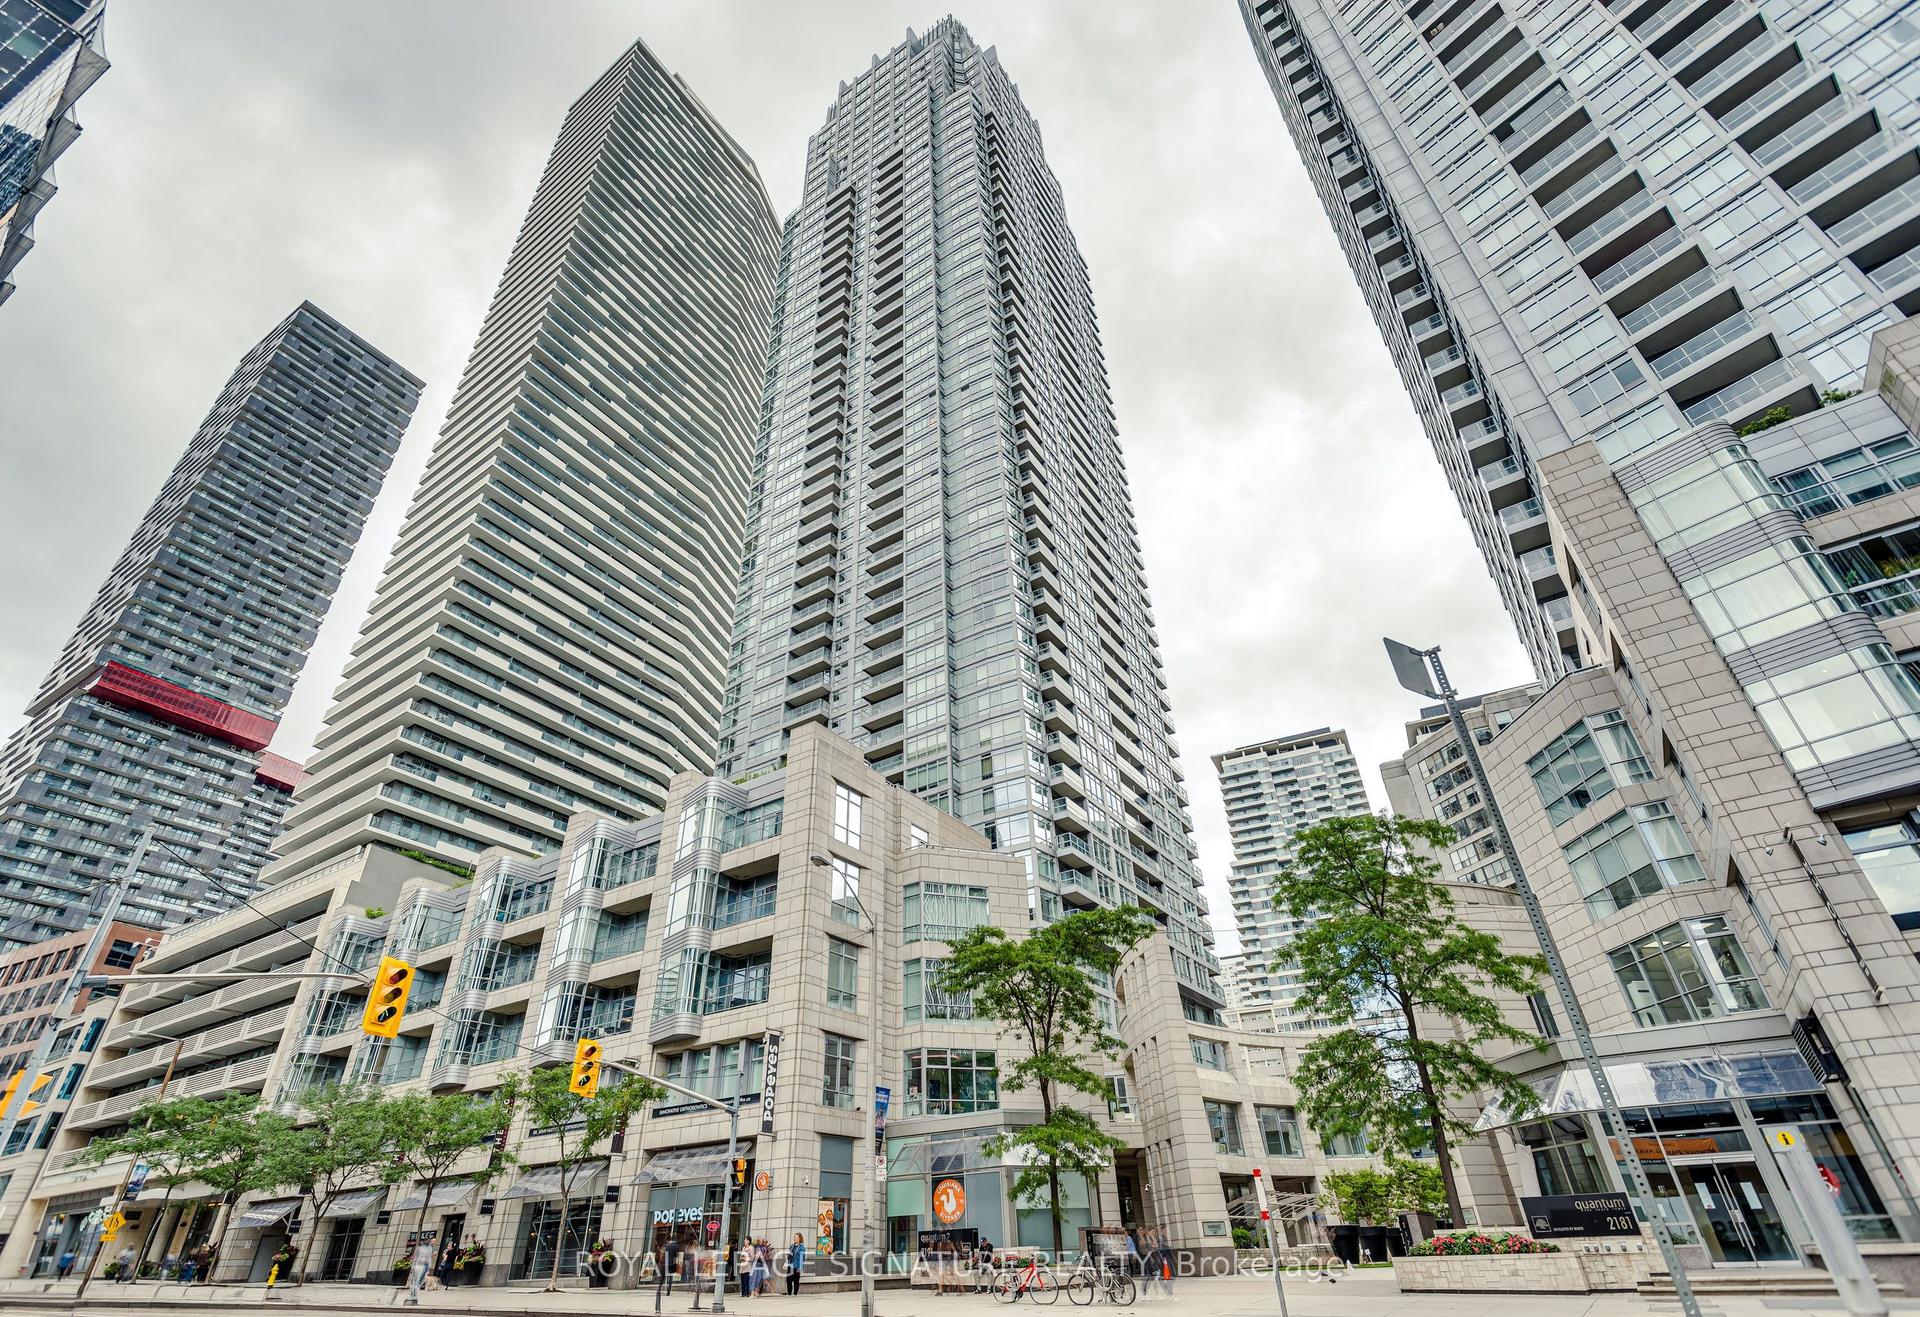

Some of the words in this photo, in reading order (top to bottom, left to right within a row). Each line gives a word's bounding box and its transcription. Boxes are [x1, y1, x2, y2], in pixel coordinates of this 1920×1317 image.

[936, 1182, 961, 1194] LOUISIANA
[1575, 1198, 1625, 1212] quantum
[940, 1211, 961, 1221] KITCHEN
[1606, 1216, 1633, 1230] 2181
